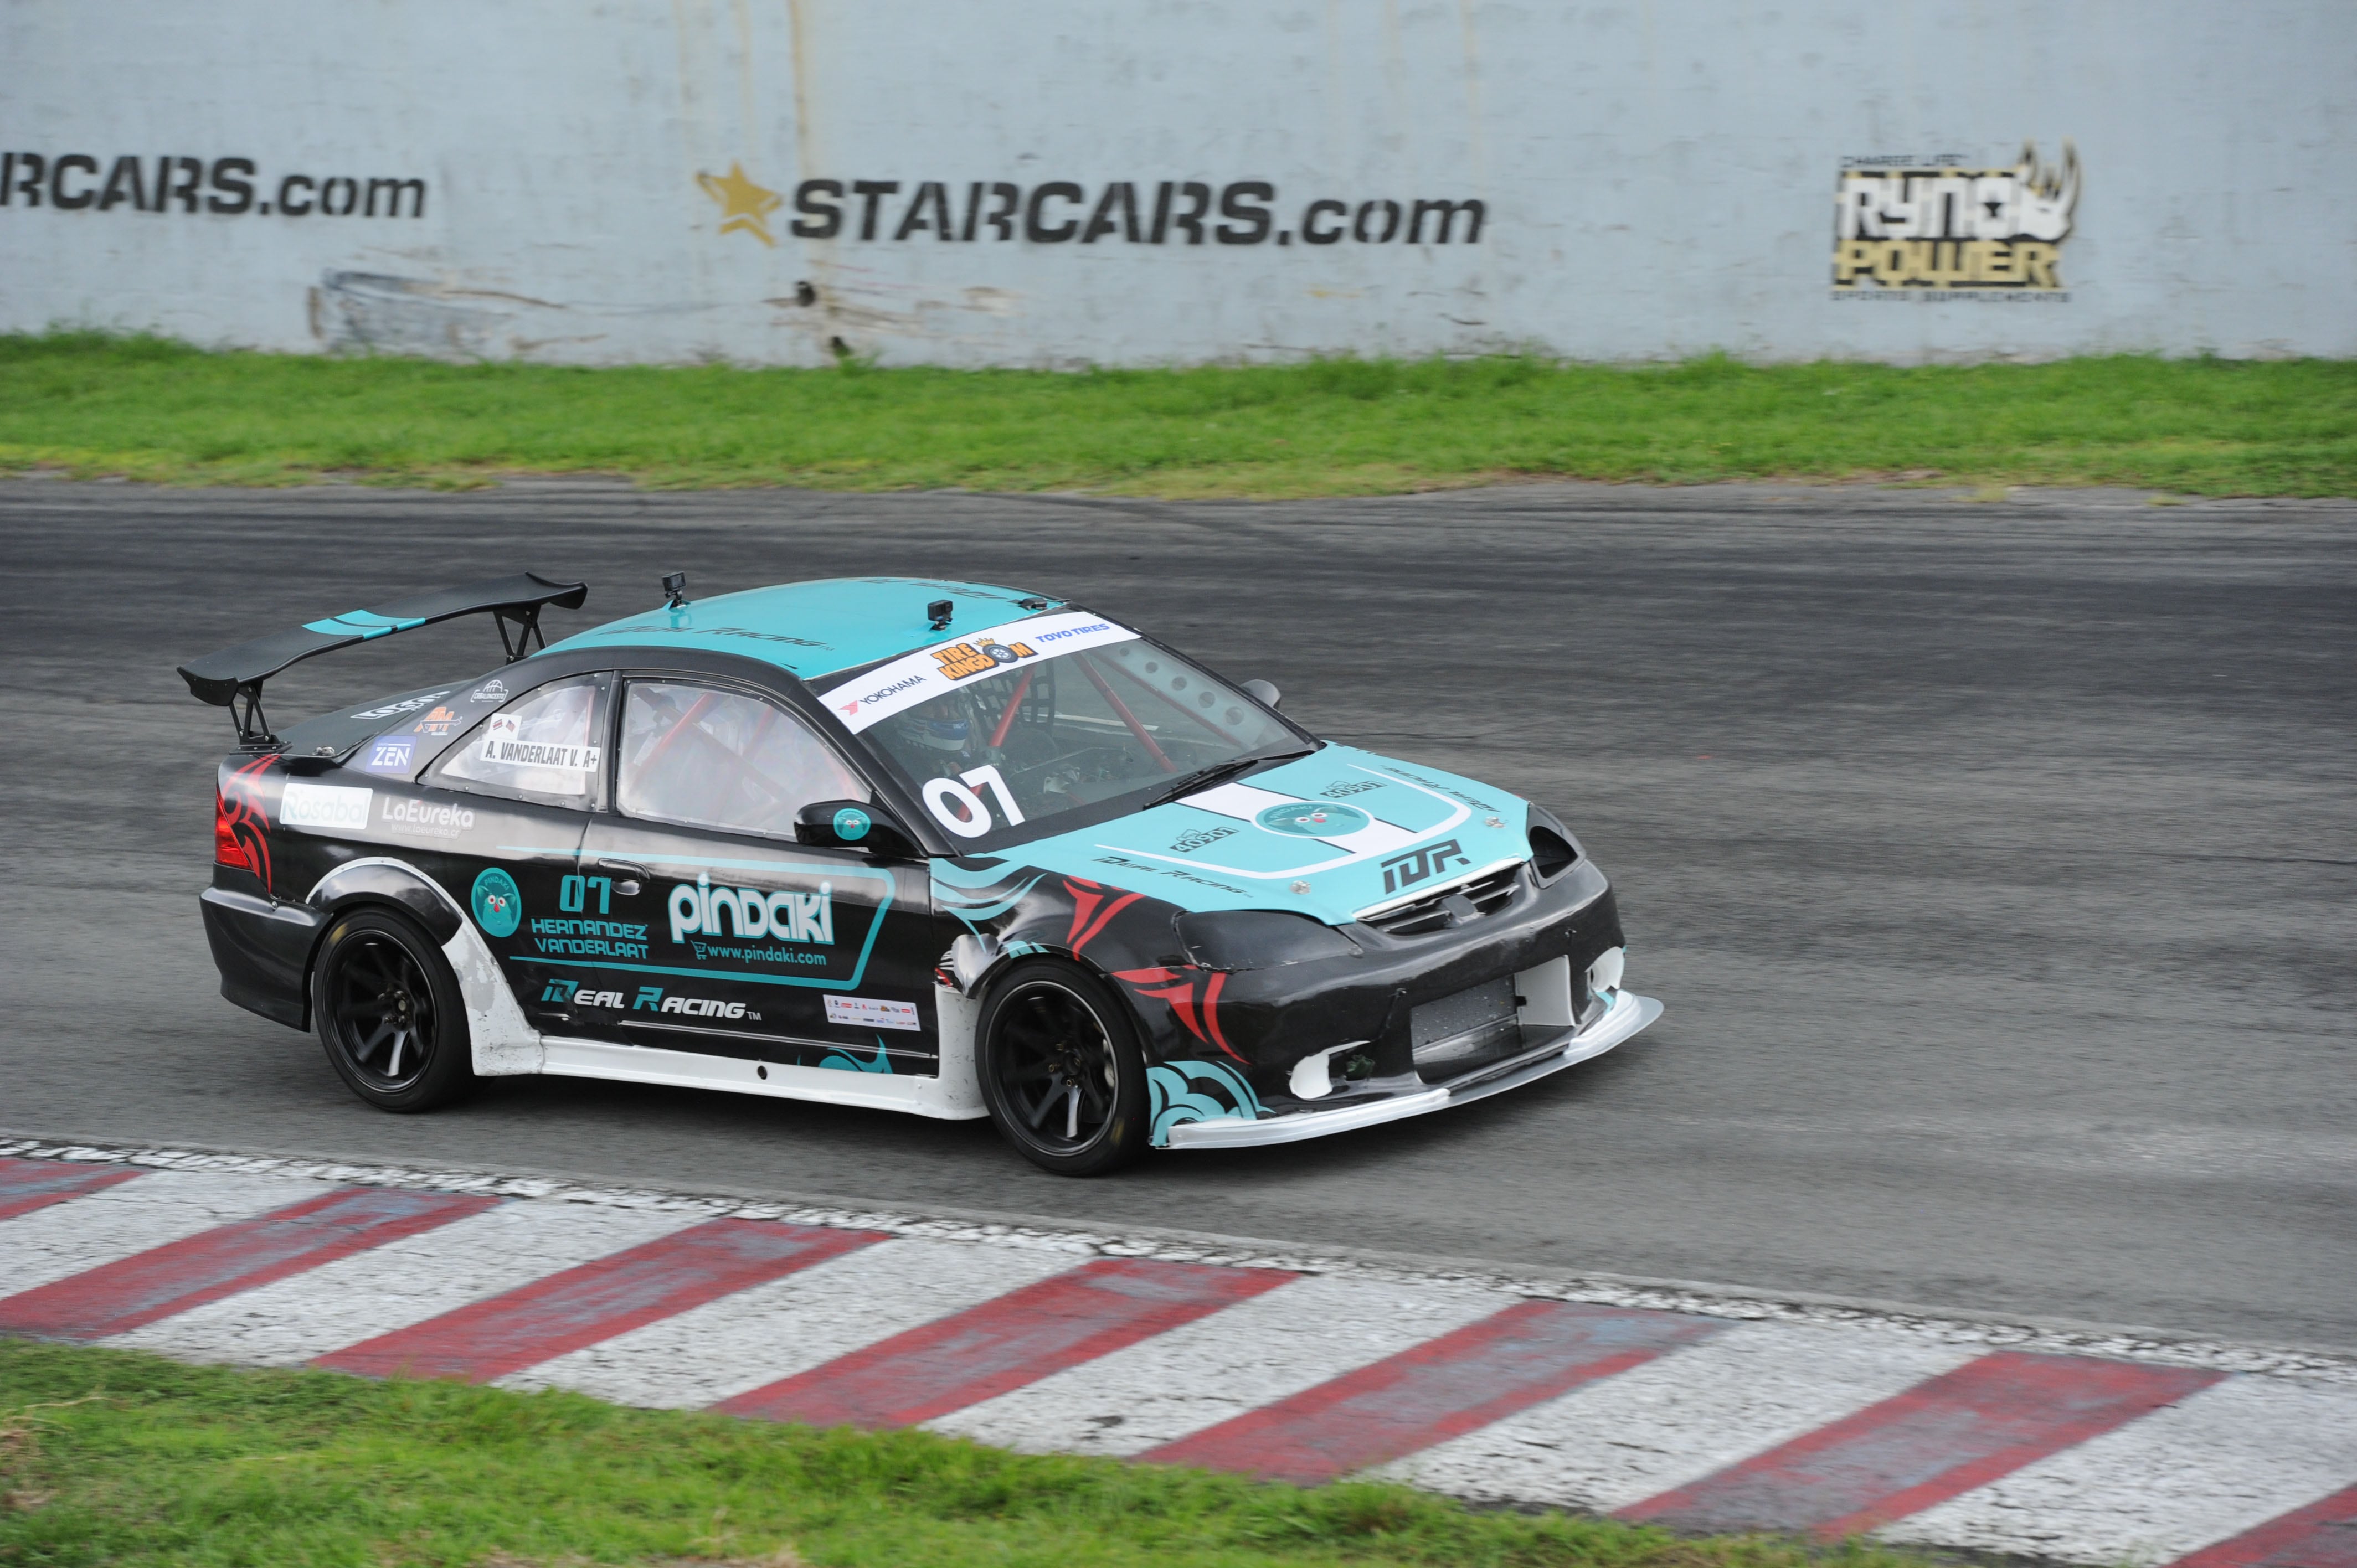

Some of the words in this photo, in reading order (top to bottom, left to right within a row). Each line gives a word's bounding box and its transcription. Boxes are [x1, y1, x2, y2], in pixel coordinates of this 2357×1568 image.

[0, 152, 428, 218] RCARS.com
[790, 178, 1488, 246] STARCARS.com
[1834, 240, 2060, 289] POWER
[1035, 629, 1073, 643] TOYO
[1070, 623, 1110, 636] TIRES
[932, 643, 978, 664] TIRE
[860, 675, 927, 706] YOKOHAMA
[371, 746, 410, 767] ZEN
[485, 741, 496, 759] A.
[500, 742, 568, 766] VANDERLAAT
[569, 749, 578, 767] V.
[583, 750, 598, 768] A+
[922, 764, 1026, 838] 07
[1324, 781, 1385, 798] 40901
[281, 791, 370, 824] Rosabal
[382, 797, 474, 828] LaEureka
[1173, 827, 1238, 852] 40901
[483, 876, 510, 891] PINDAKI
[559, 874, 613, 915] 07
[531, 918, 647, 941] HERNANDEZ
[534, 938, 649, 960] VANDERLAAT
[707, 944, 827, 966] www.pindaki.com
[632, 986, 747, 1019] RACING
